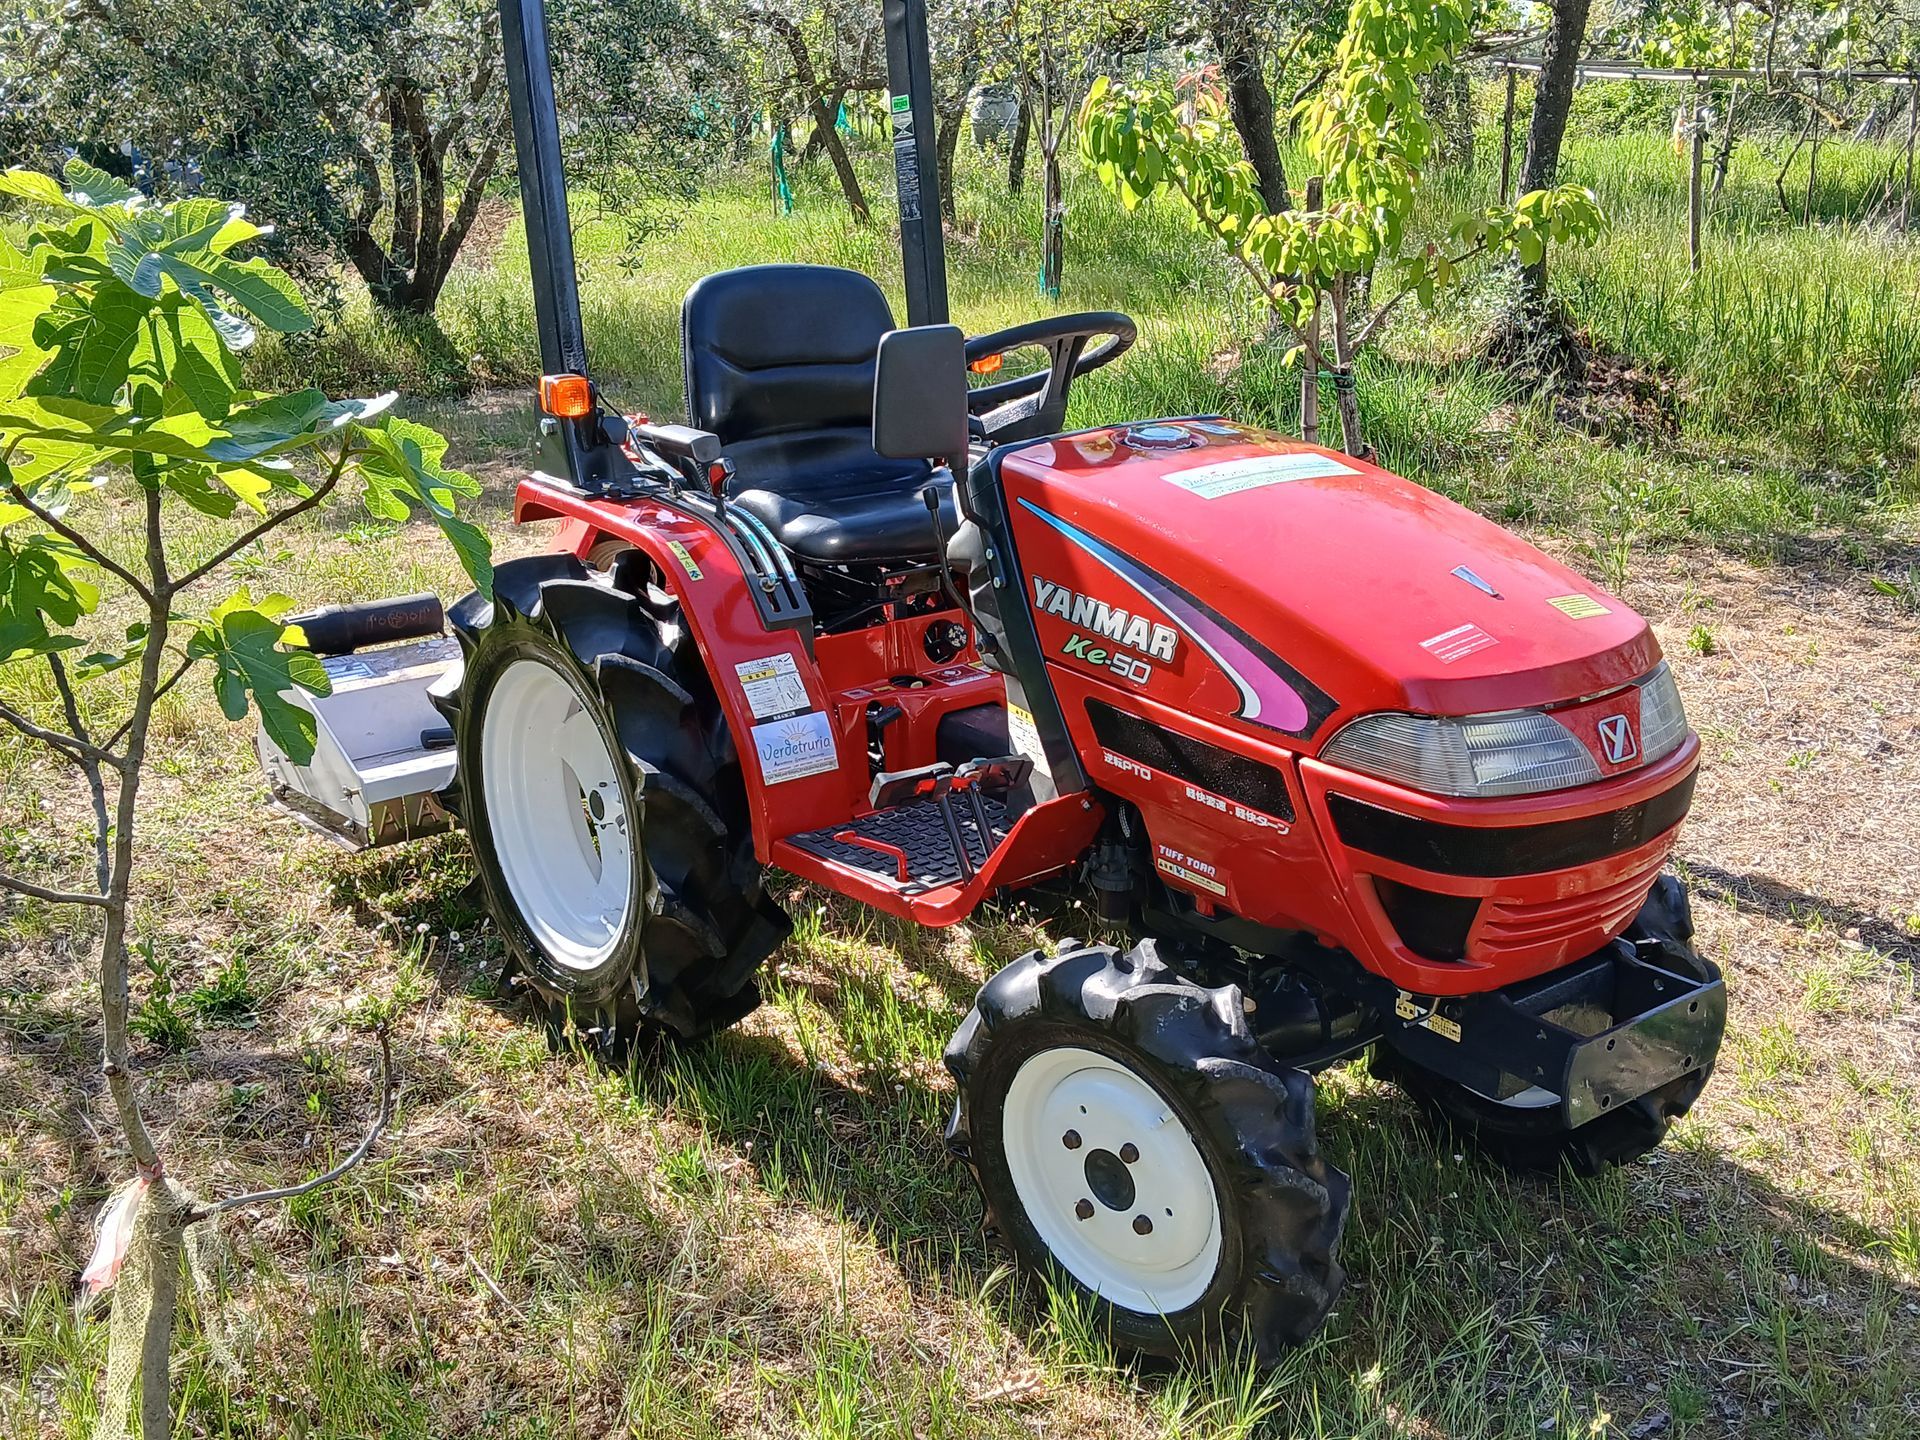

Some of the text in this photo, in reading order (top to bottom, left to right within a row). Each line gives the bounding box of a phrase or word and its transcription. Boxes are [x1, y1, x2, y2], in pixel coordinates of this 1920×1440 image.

[1033, 575, 1177, 662] YANMAR
[1062, 634, 1152, 685] Ke-50
[762, 735, 831, 761] Verdetruria
[1159, 844, 1184, 862] TUFF
[1186, 856, 1217, 878] TORQ
